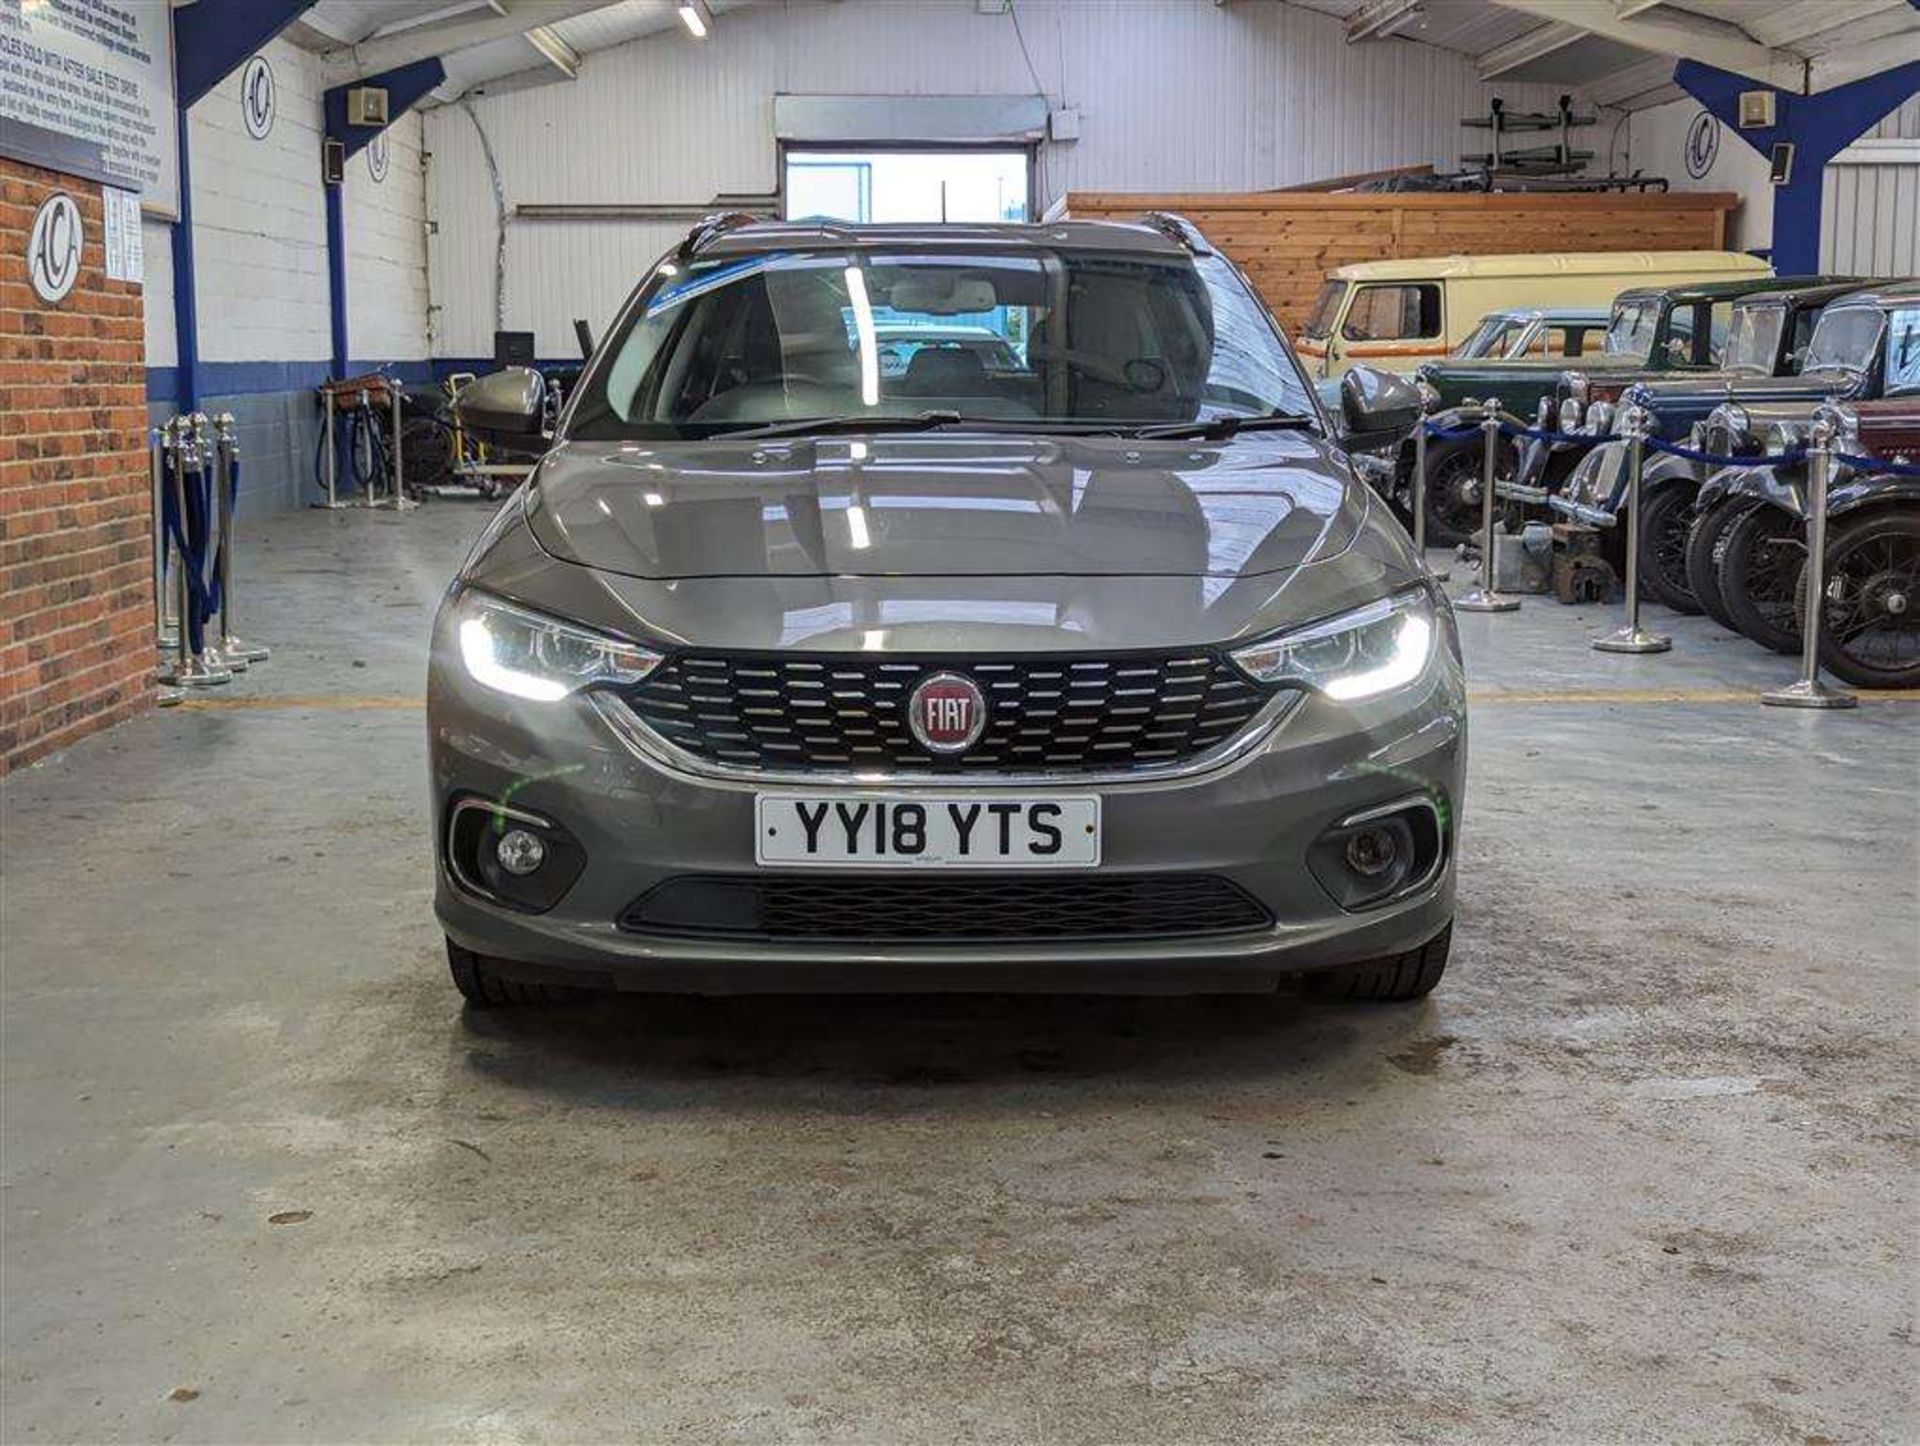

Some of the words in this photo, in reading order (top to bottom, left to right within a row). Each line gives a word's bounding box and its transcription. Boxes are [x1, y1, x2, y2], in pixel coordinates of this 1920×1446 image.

[926, 697, 971, 732] FIAT
[795, 801, 927, 856] YY18
[947, 802, 1063, 857] YTS
